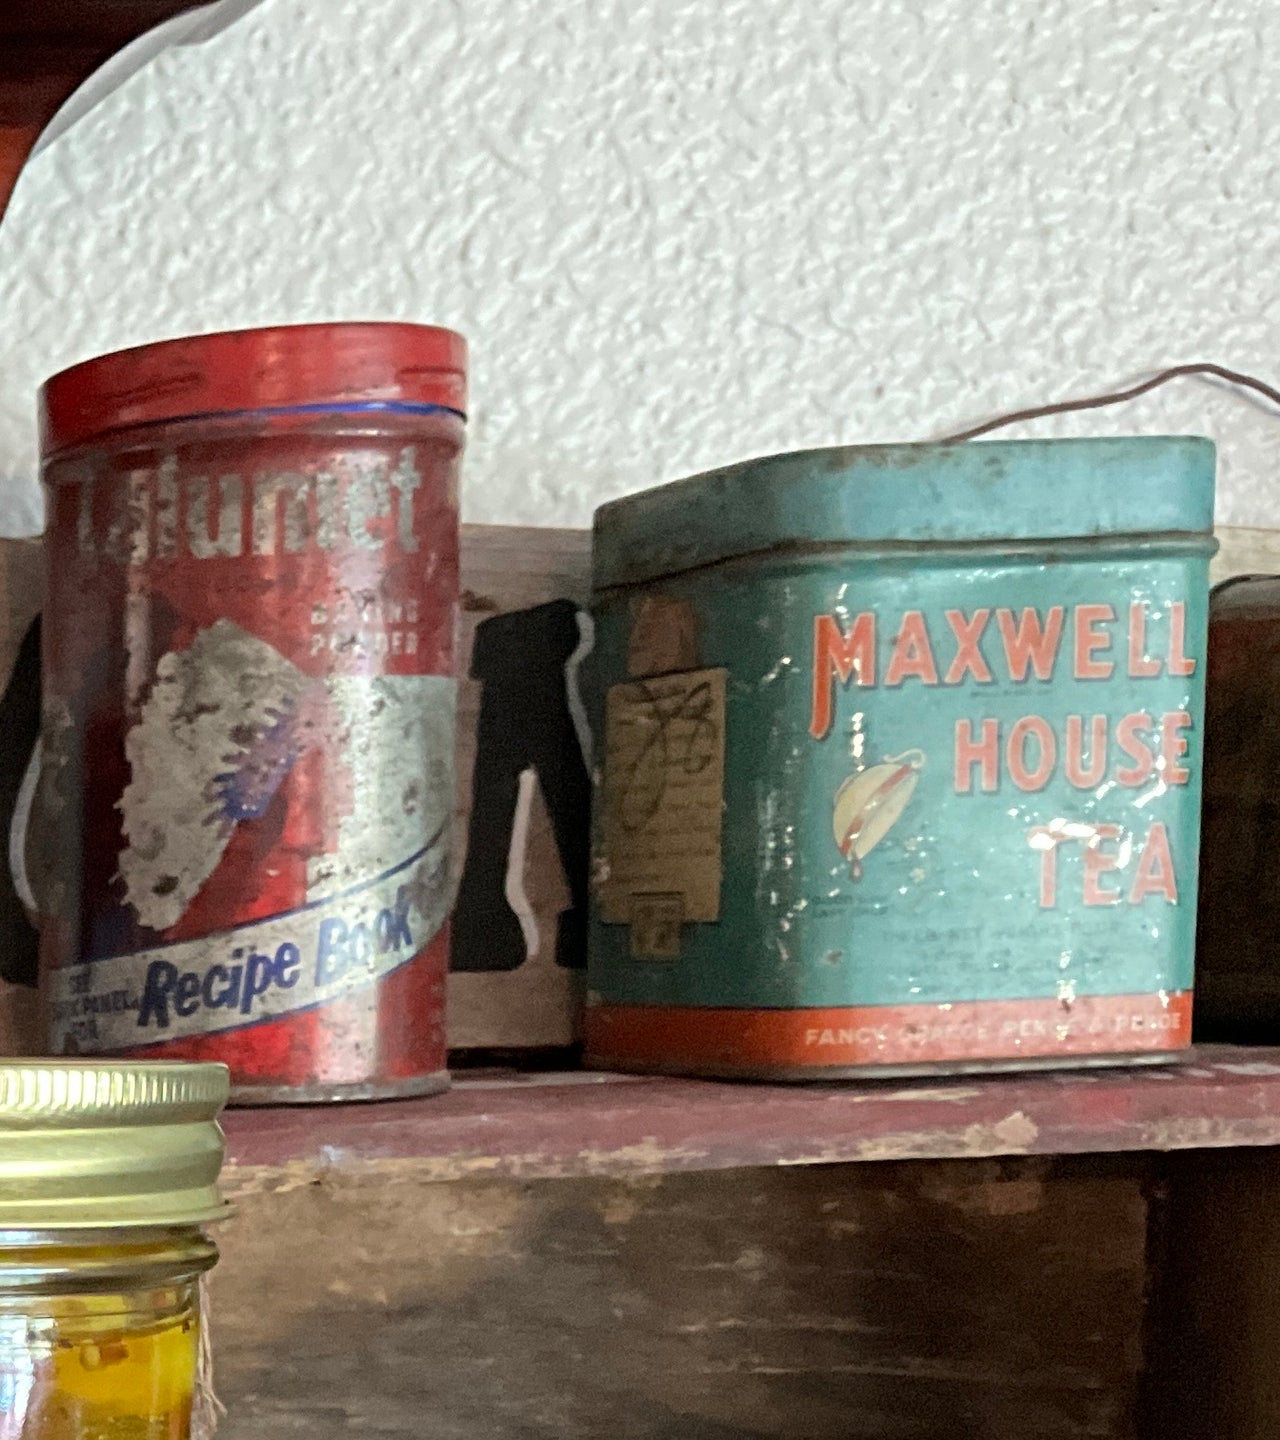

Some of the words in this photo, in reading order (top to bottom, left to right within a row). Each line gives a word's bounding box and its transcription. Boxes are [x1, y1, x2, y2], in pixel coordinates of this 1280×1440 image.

[809, 602, 1196, 740] MAXWELL
[954, 711, 1192, 794] HOUSE
[1027, 822, 1178, 909] TEA
[136, 942, 302, 1028] Recipe
[314, 898, 416, 987] Book
